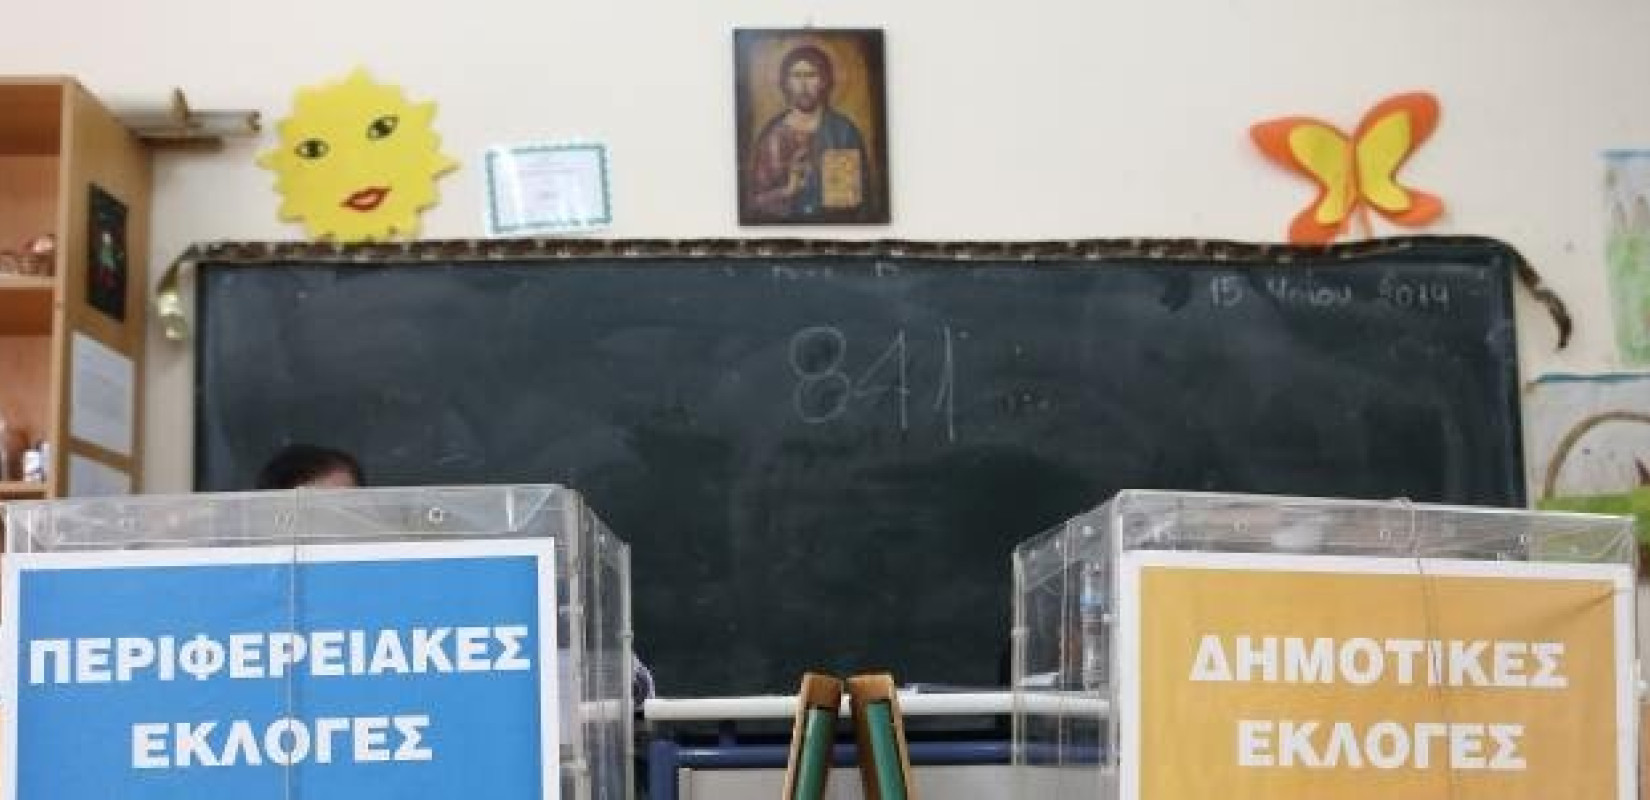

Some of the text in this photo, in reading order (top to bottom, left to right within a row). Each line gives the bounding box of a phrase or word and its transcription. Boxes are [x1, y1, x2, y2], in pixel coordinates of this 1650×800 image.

[1210, 274, 1242, 307] 15
[790, 326, 954, 441] 841
[29, 626, 531, 684] ΠΕΡΙΦΕΡΕΙΑΚΕΣ
[1189, 635, 1568, 687] ΔΗΜΟΤΙΚΕΣ
[132, 715, 433, 769] ΕΚΛΟΓΕΣ
[1237, 719, 1527, 769] ΕΚΛΟΓΕΣ
